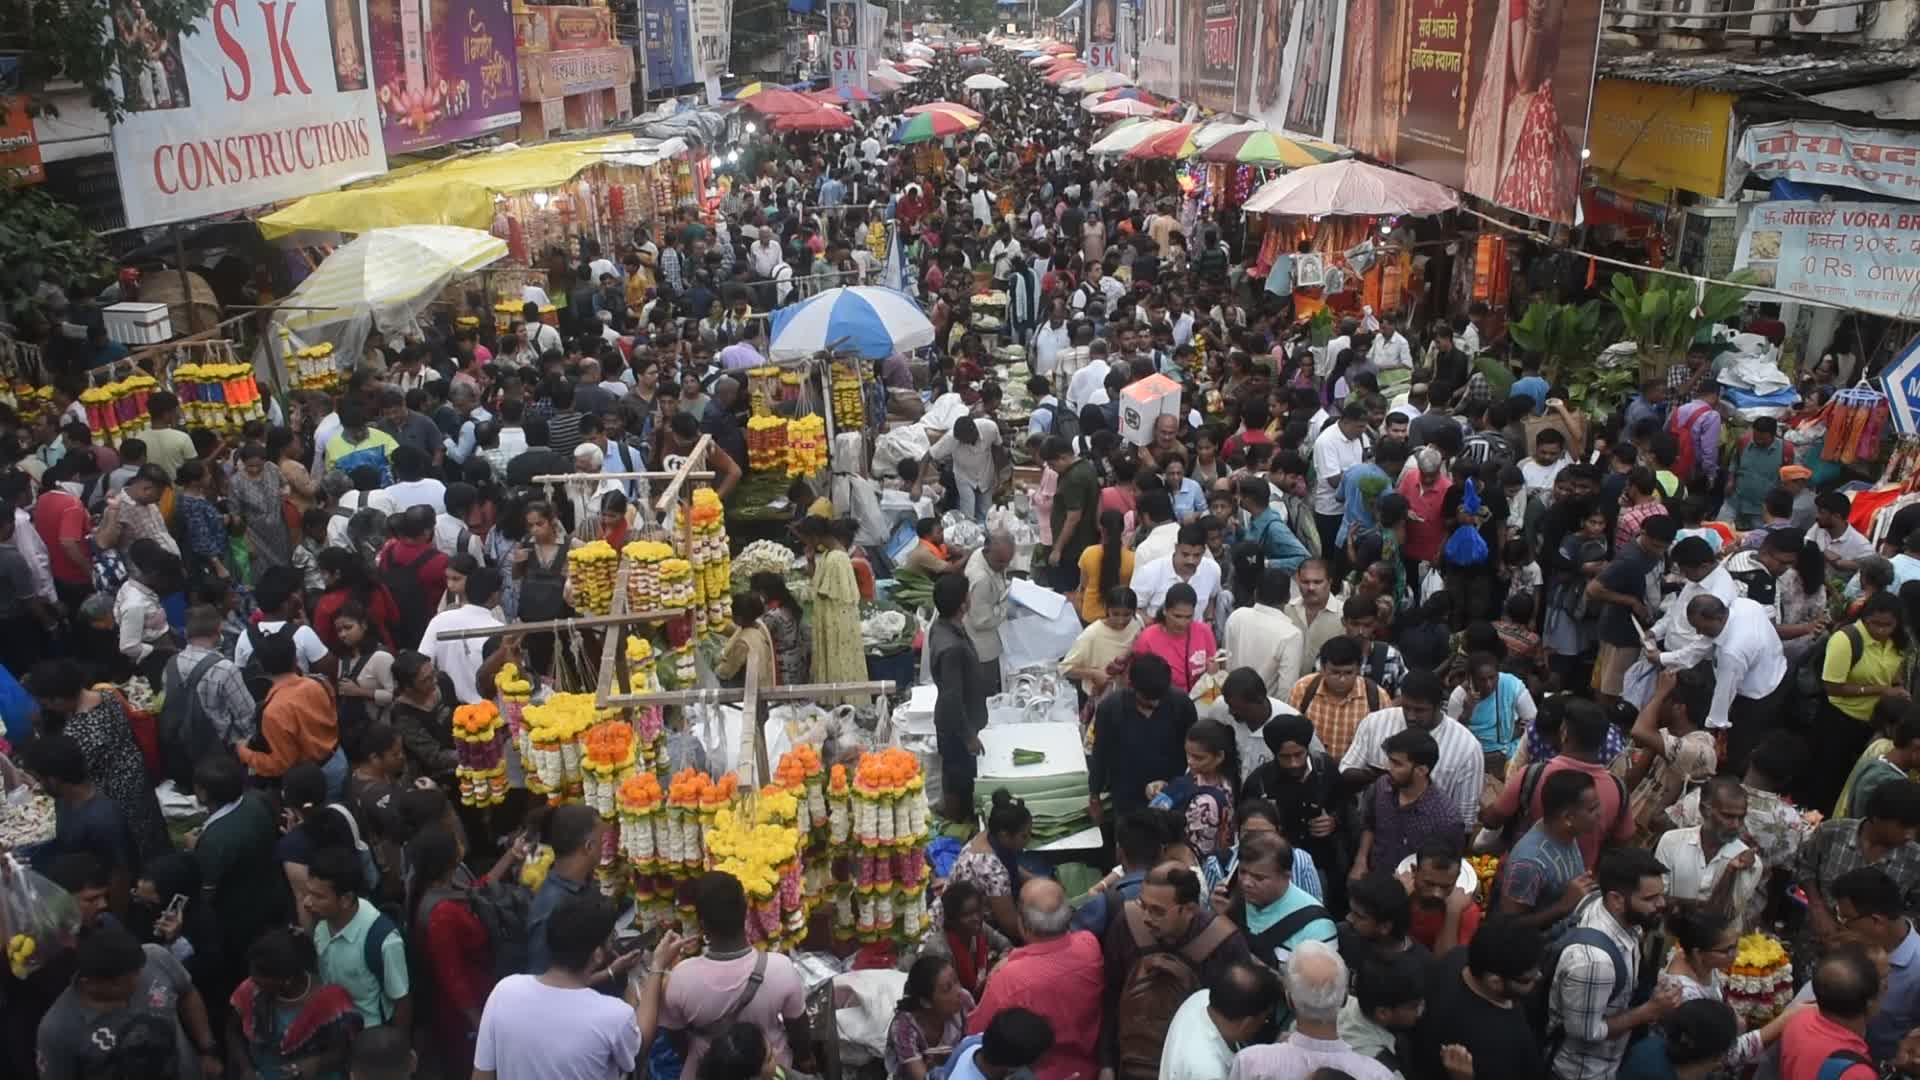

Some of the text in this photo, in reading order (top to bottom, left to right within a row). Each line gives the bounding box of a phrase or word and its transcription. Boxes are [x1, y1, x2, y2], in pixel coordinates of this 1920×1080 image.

[1418, 10, 1457, 40] सर्व भक्तांचे
[1411, 41, 1462, 72] हार्दिक स्वागत
[153, 117, 370, 195] CONSTRUCTIONS
[1842, 211, 1891, 229] VORA
[1823, 256, 1856, 278] Rs.
